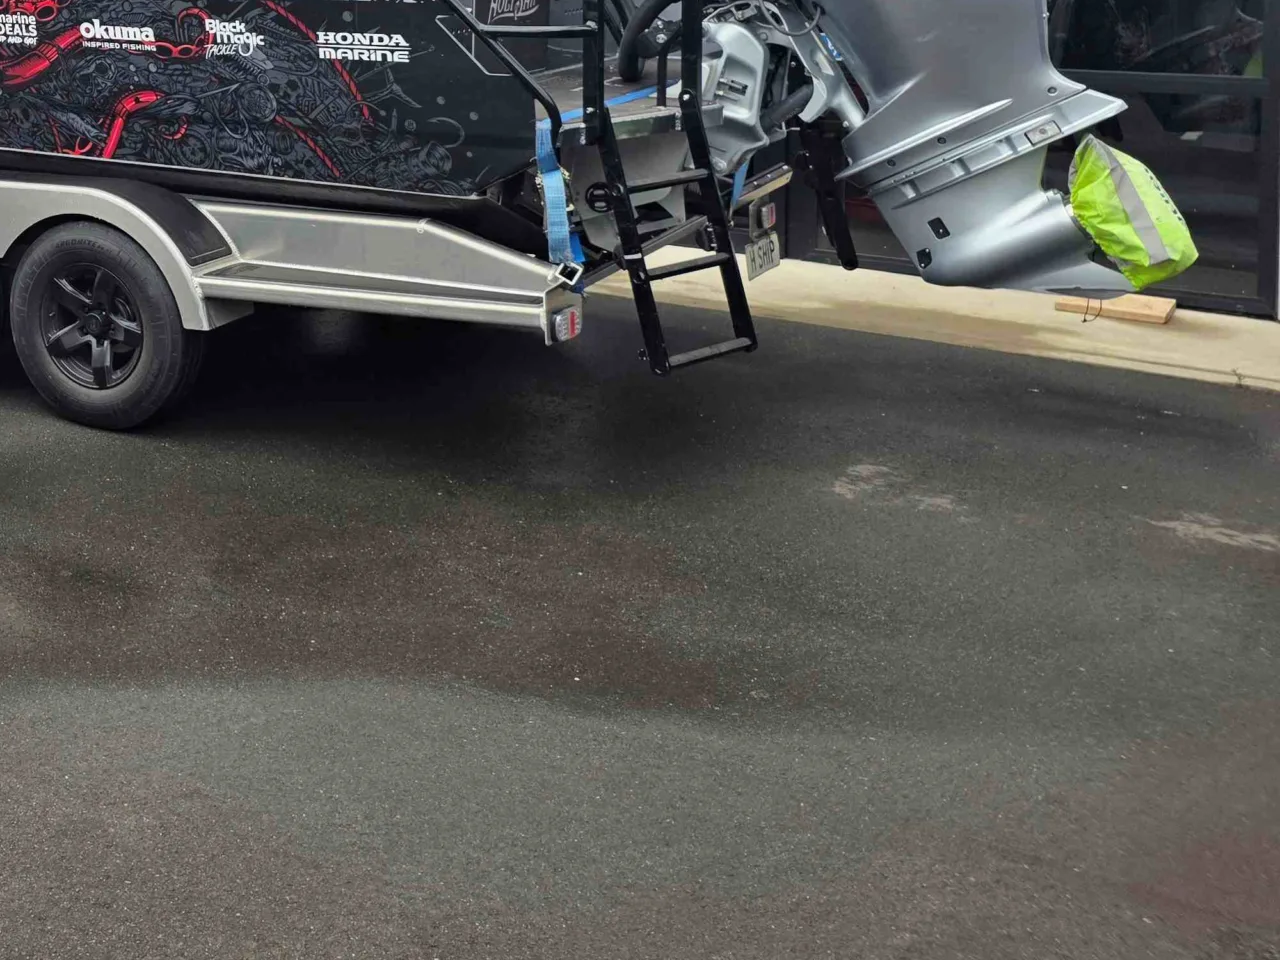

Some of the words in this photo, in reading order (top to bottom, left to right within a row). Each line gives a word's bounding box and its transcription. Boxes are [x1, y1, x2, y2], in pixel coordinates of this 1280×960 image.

[205, 19, 246, 33] Black
[316, 31, 410, 46] HONDA
[82, 41, 120, 49] INSPIRED
[122, 43, 157, 52] FISHING
[204, 44, 239, 60] TACKLE
[749, 249, 757, 273] H
[758, 239, 775, 269] SHIP
